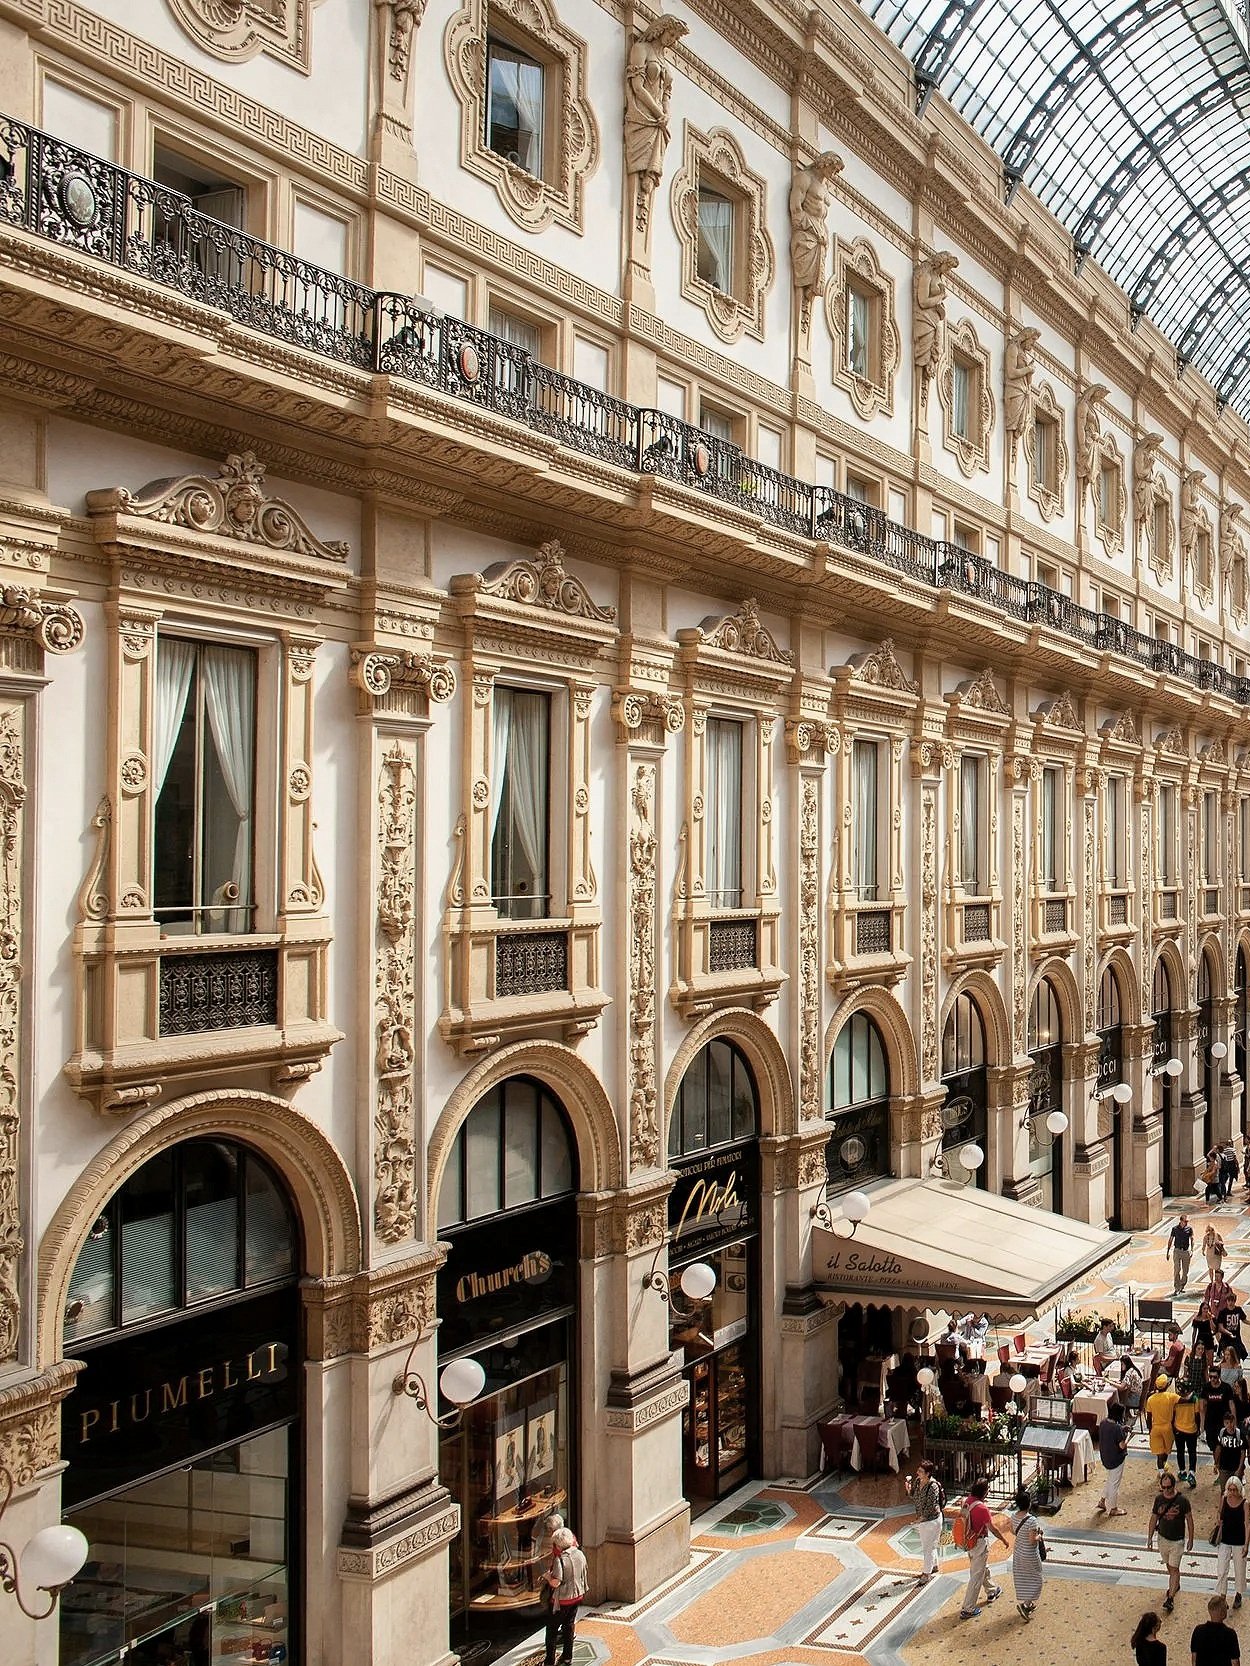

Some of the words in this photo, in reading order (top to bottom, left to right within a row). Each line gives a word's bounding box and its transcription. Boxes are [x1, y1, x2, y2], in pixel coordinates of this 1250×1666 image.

[1097, 1059, 1116, 1077] UCCI
[826, 1252, 841, 1269] il
[845, 1253, 903, 1274] Salotto
[456, 1251, 550, 1302] Church's
[1226, 1313, 1240, 1327] 501
[79, 1343, 278, 1444] PIUMELLI
